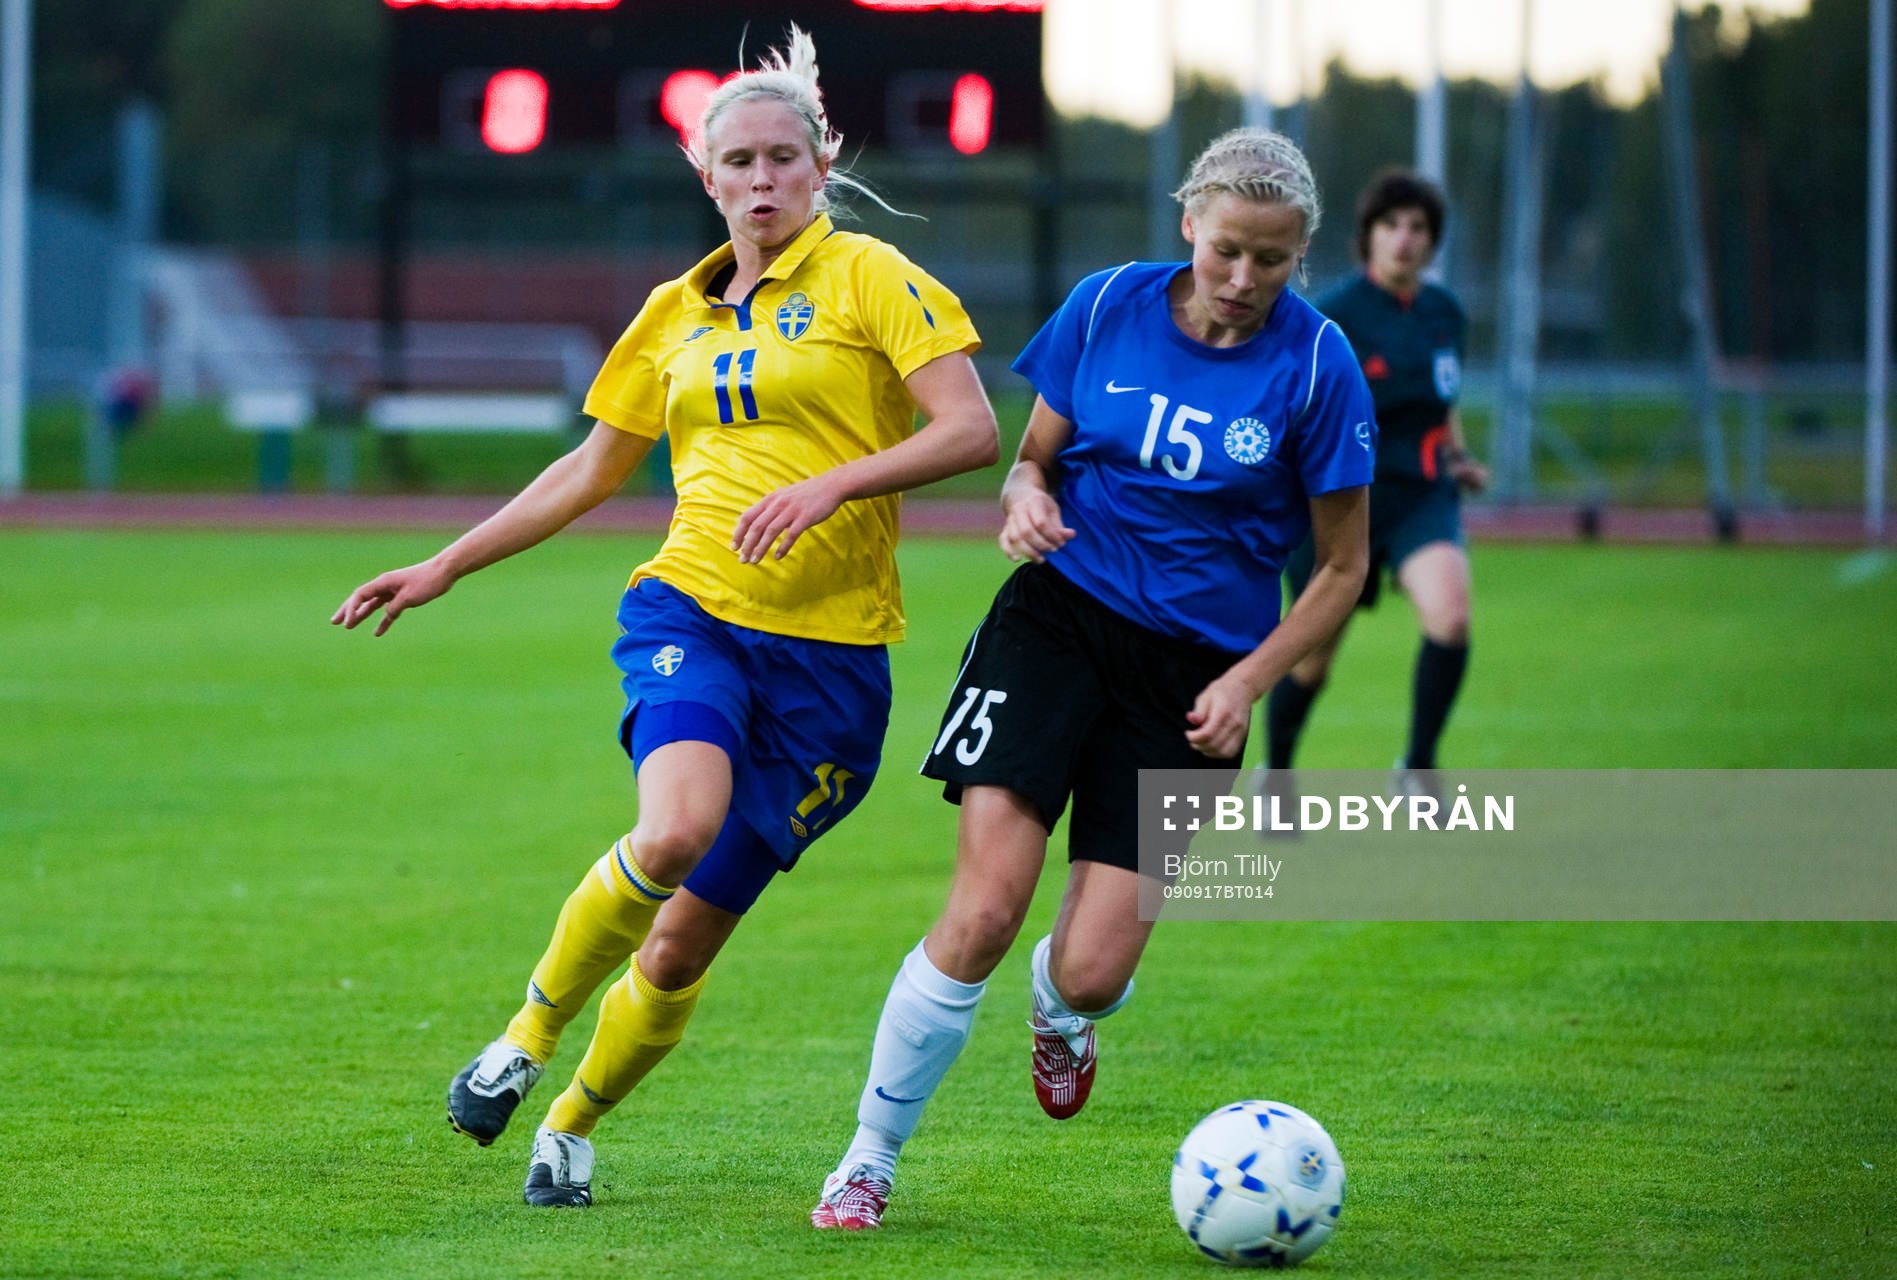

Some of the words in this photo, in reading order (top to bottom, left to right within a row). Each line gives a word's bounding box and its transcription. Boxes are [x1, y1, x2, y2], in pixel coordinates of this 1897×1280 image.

[712, 348, 760, 425] 11
[1138, 393, 1213, 481] 15
[933, 686, 1008, 767] 15
